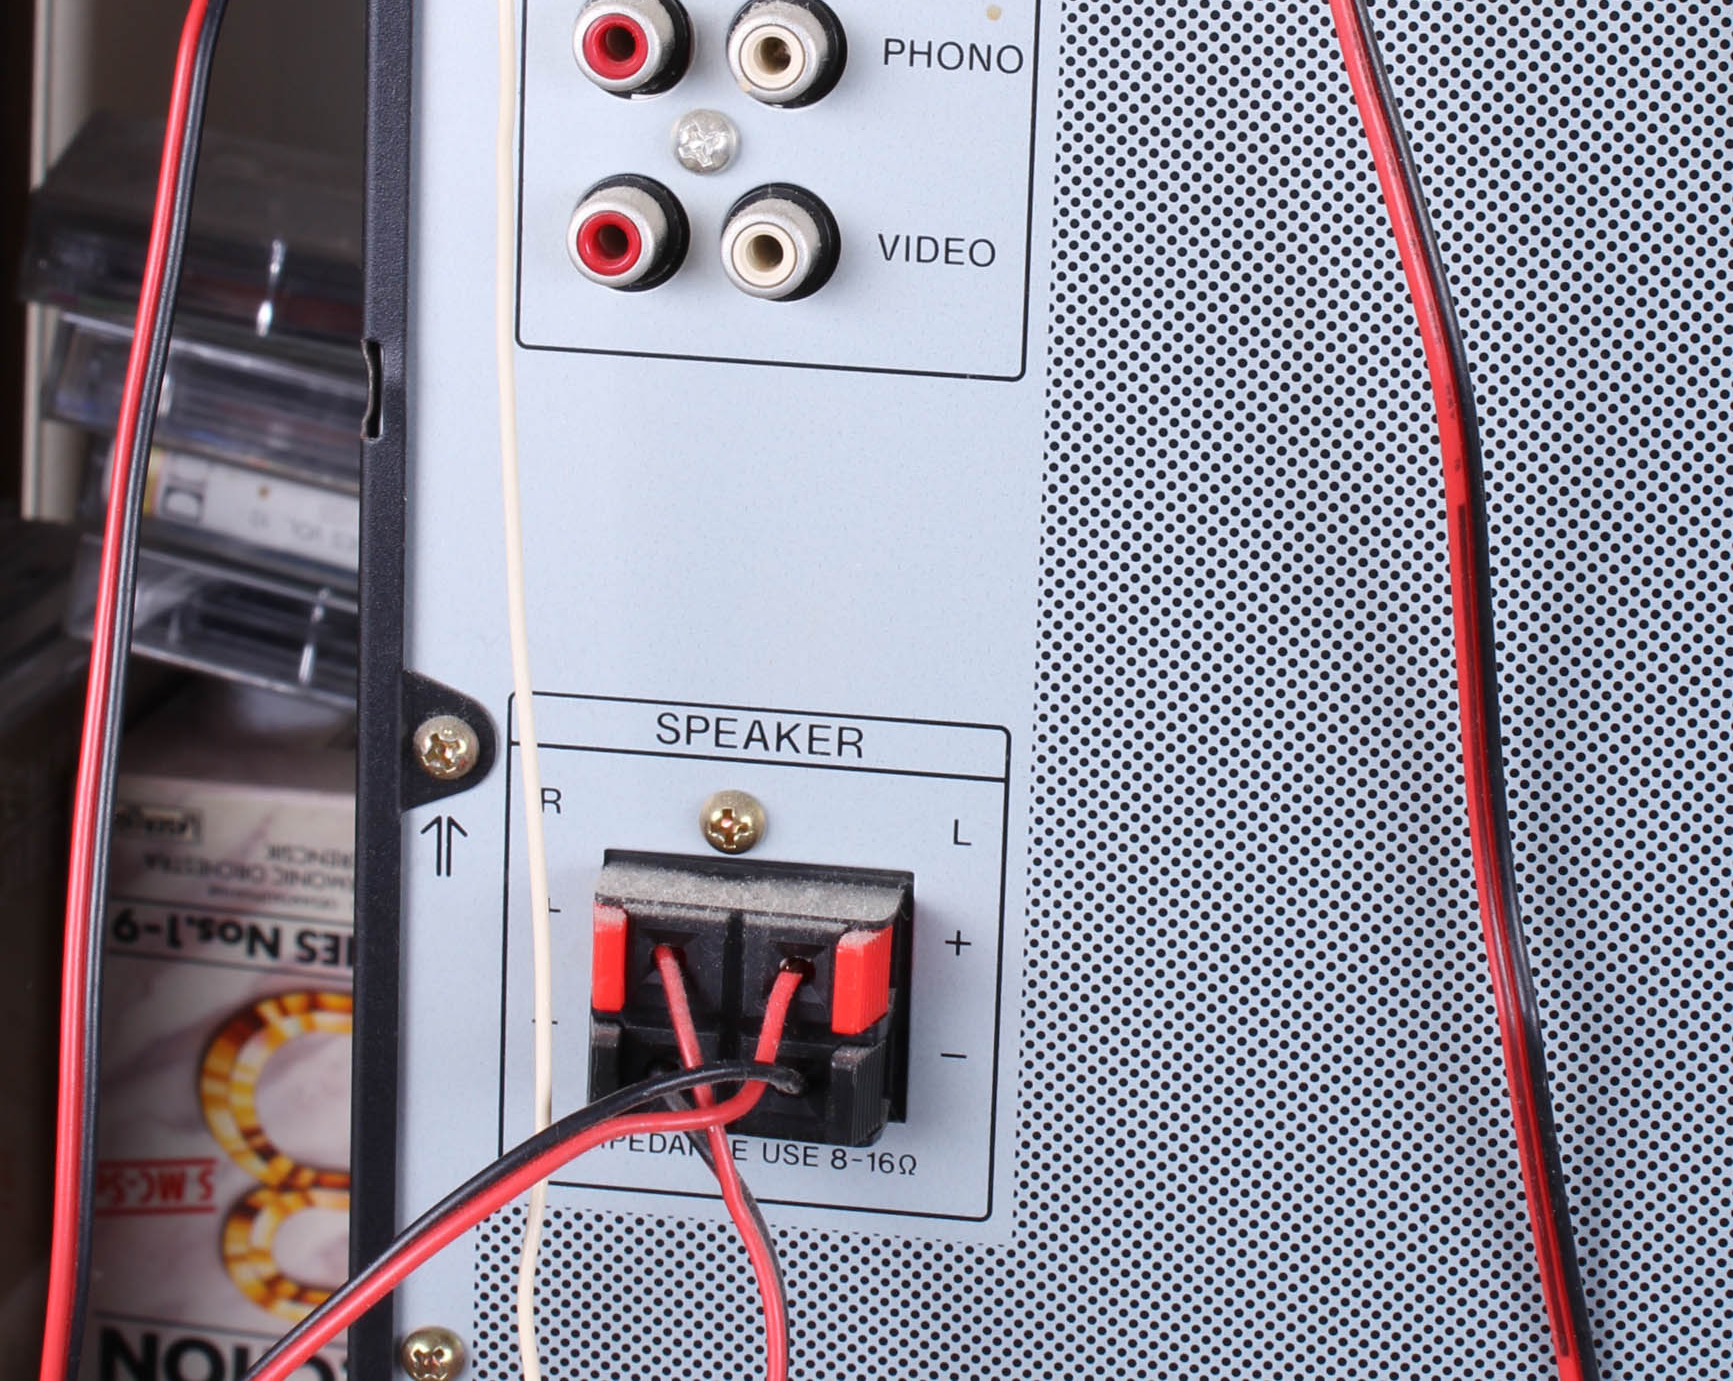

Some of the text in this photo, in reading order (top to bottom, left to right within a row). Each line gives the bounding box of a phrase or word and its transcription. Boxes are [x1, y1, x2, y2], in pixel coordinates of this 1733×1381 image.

[883, 37, 1025, 75] PHONO
[877, 233, 997, 268] VIDEO
[655, 711, 865, 760] SPEAKER
[540, 786, 562, 815] R
[953, 819, 972, 846] L
[762, 1141, 819, 1168] USE
